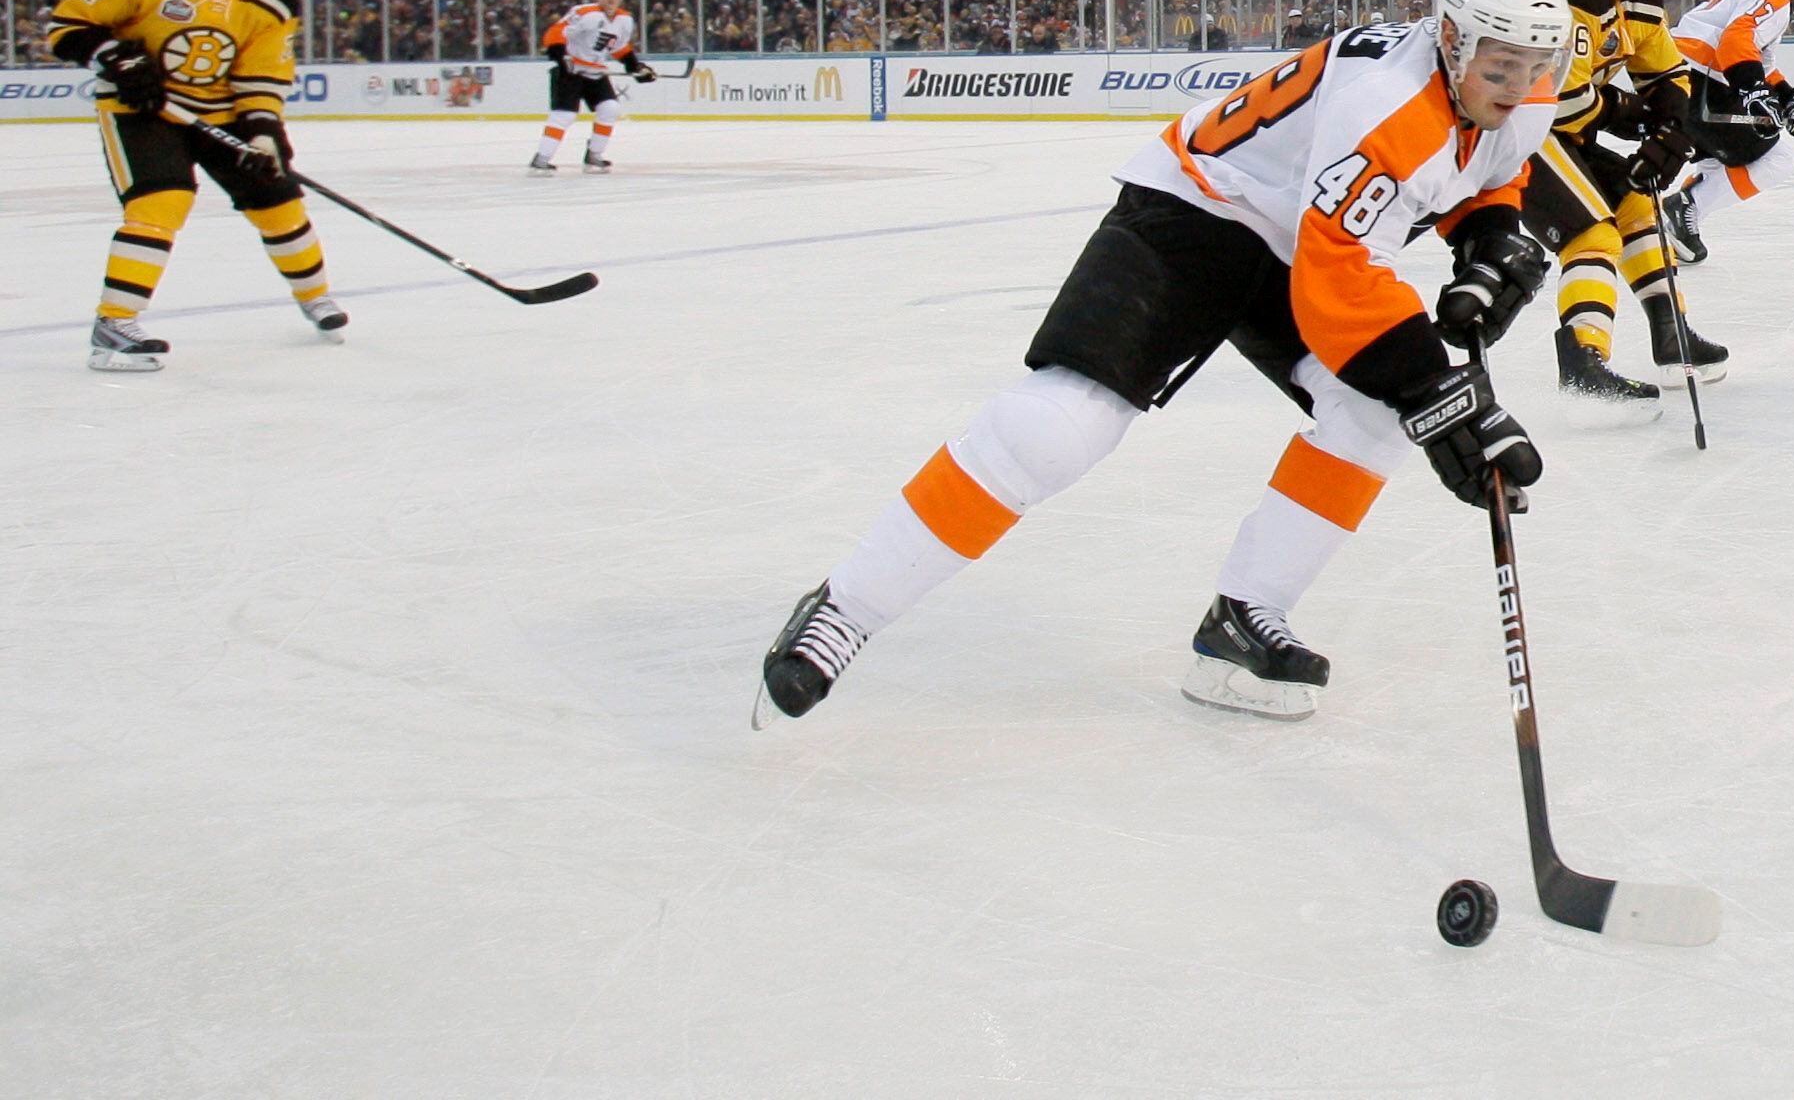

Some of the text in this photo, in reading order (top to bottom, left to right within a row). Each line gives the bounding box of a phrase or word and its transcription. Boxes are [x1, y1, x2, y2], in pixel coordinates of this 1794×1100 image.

[0, 84, 73, 98] BUD
[721, 83, 806, 101] i'm lovin' it
[872, 58, 884, 114] Reebok
[903, 68, 1074, 98] BRIDGESTONE
[1100, 70, 1171, 90] BUD
[1311, 150, 1399, 238] 48
[1415, 396, 1468, 434] BAUER
